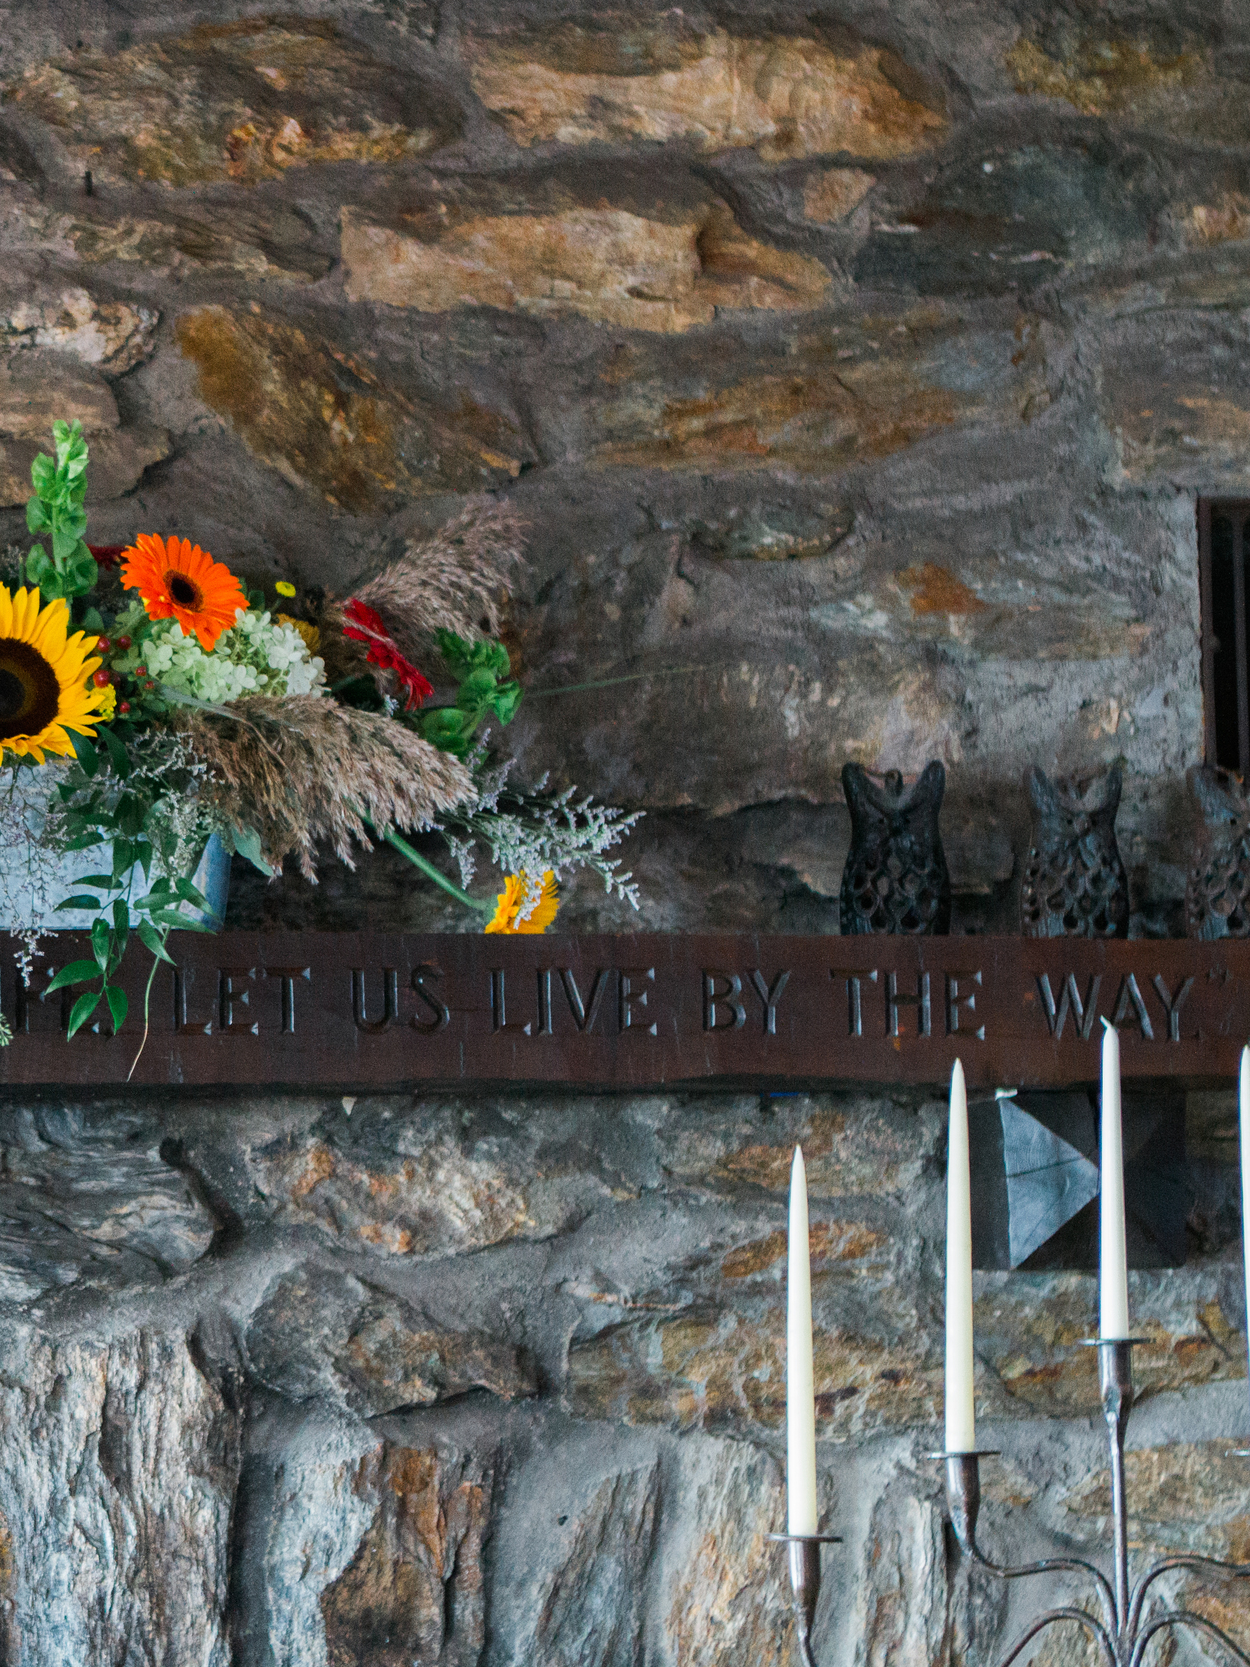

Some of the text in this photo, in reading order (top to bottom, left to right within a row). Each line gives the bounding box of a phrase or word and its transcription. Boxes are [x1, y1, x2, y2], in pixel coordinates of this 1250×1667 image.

[171, 966, 311, 1036] LET
[350, 964, 450, 1035] US
[490, 967, 658, 1036] LIVE
[701, 967, 792, 1035] BY
[830, 968, 986, 1041] THE
